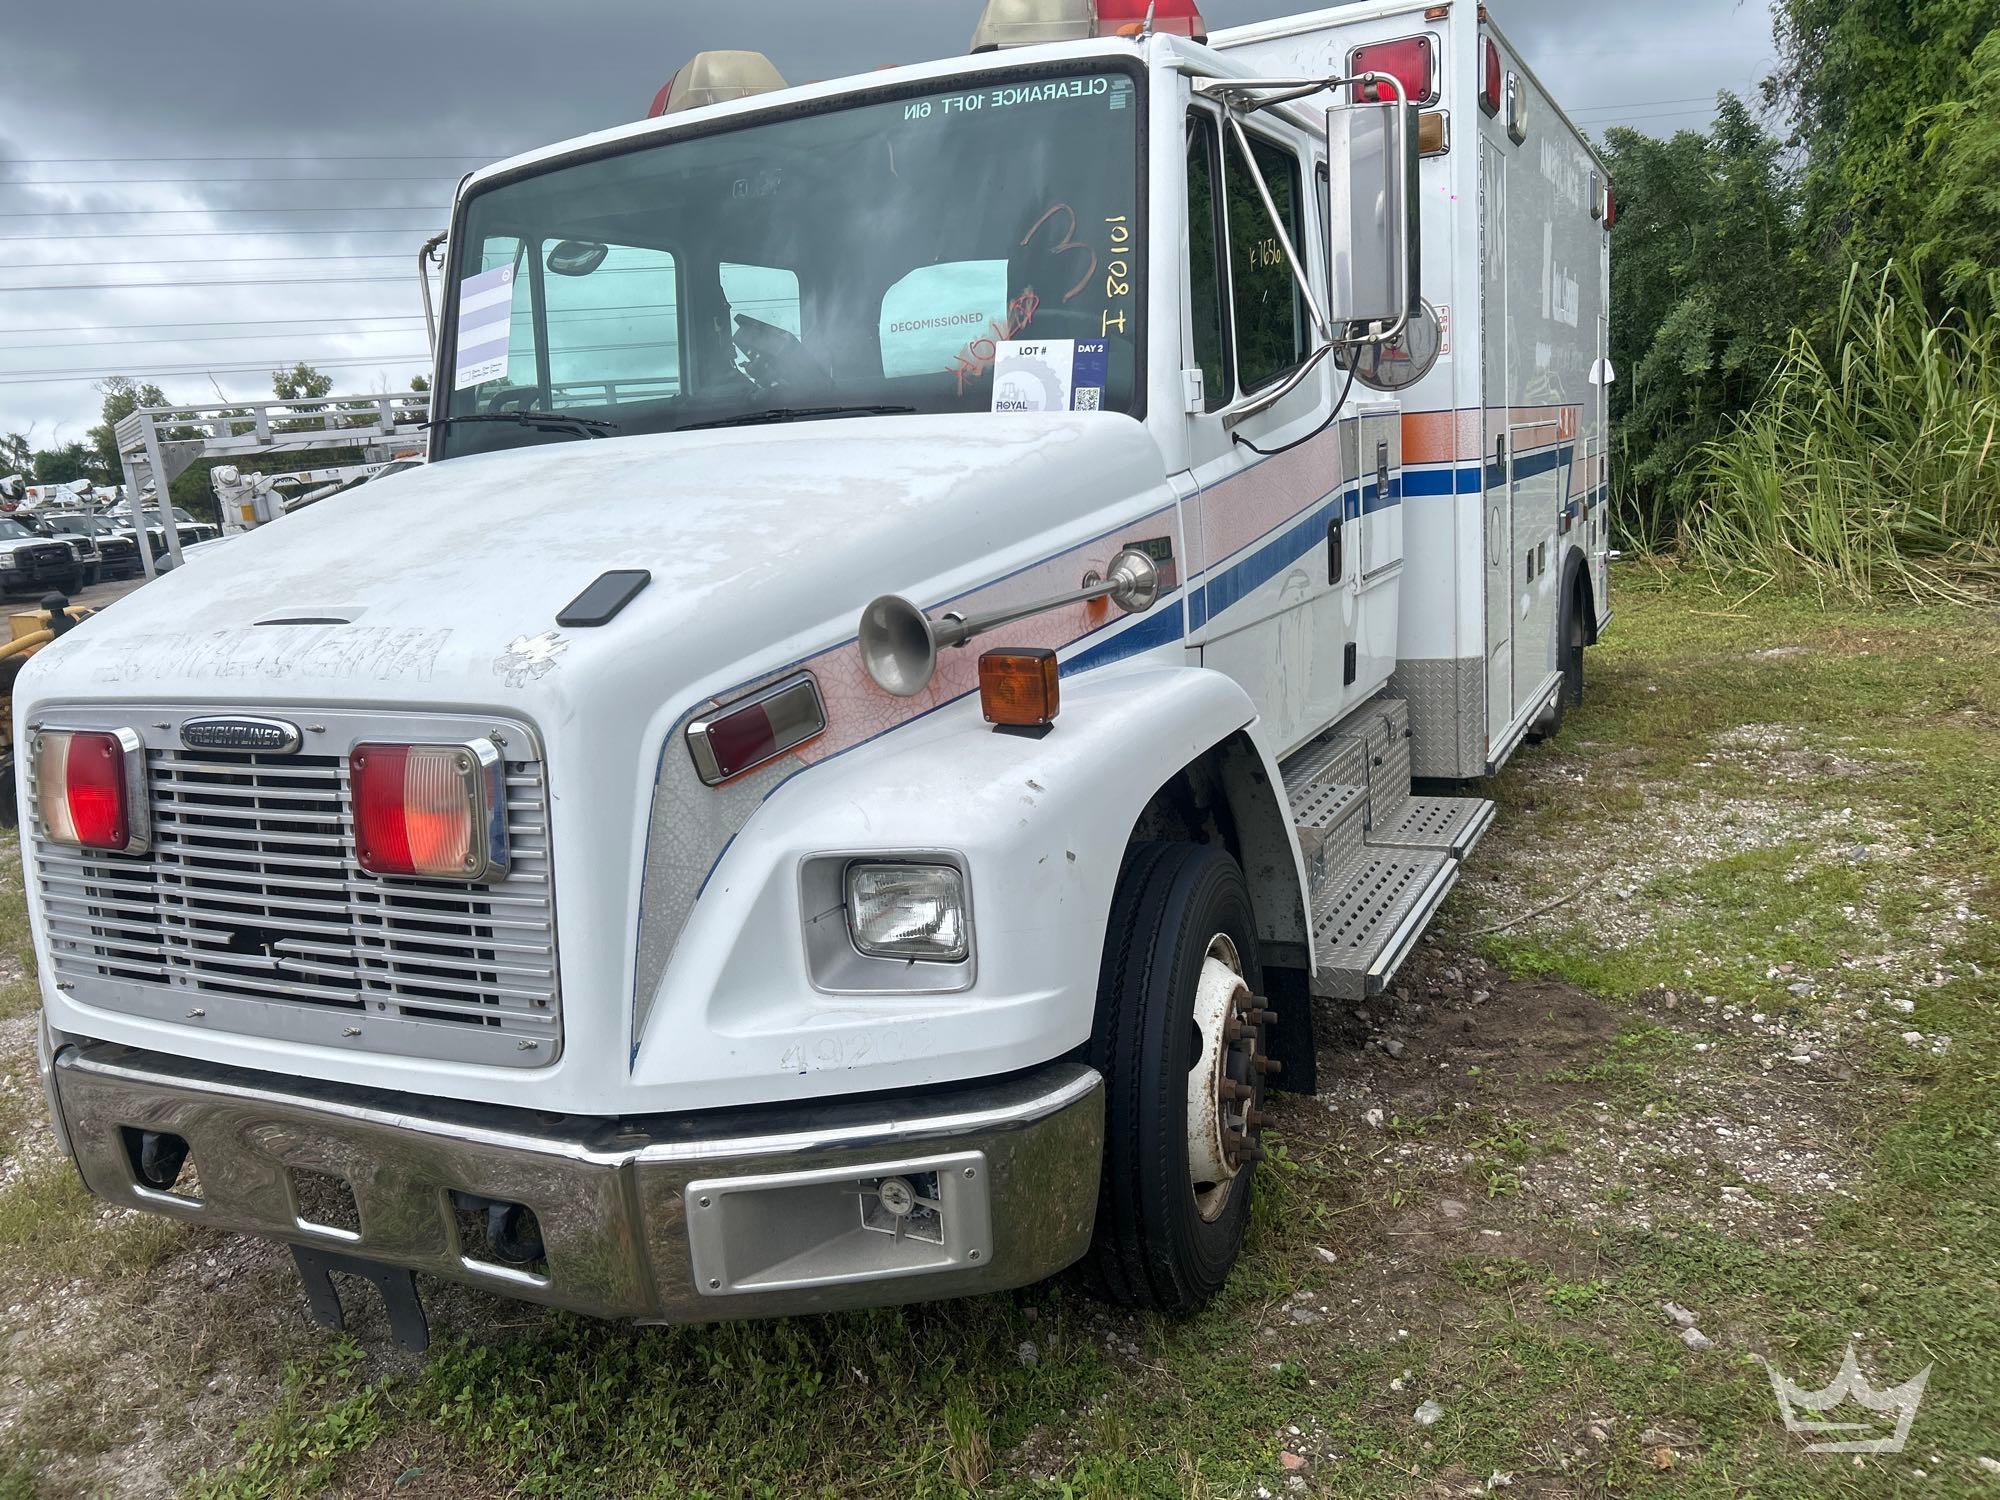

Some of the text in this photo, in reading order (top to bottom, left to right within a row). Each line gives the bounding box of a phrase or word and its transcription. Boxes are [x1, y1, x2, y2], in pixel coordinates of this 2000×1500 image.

[890, 312, 984, 333] DECOMISSIONED
[1019, 346, 1039, 356] LOT
[1078, 344, 1104, 353] DAY 2
[996, 401, 1028, 410] ROYAL
[188, 726, 282, 746] FREIGHTLINER
